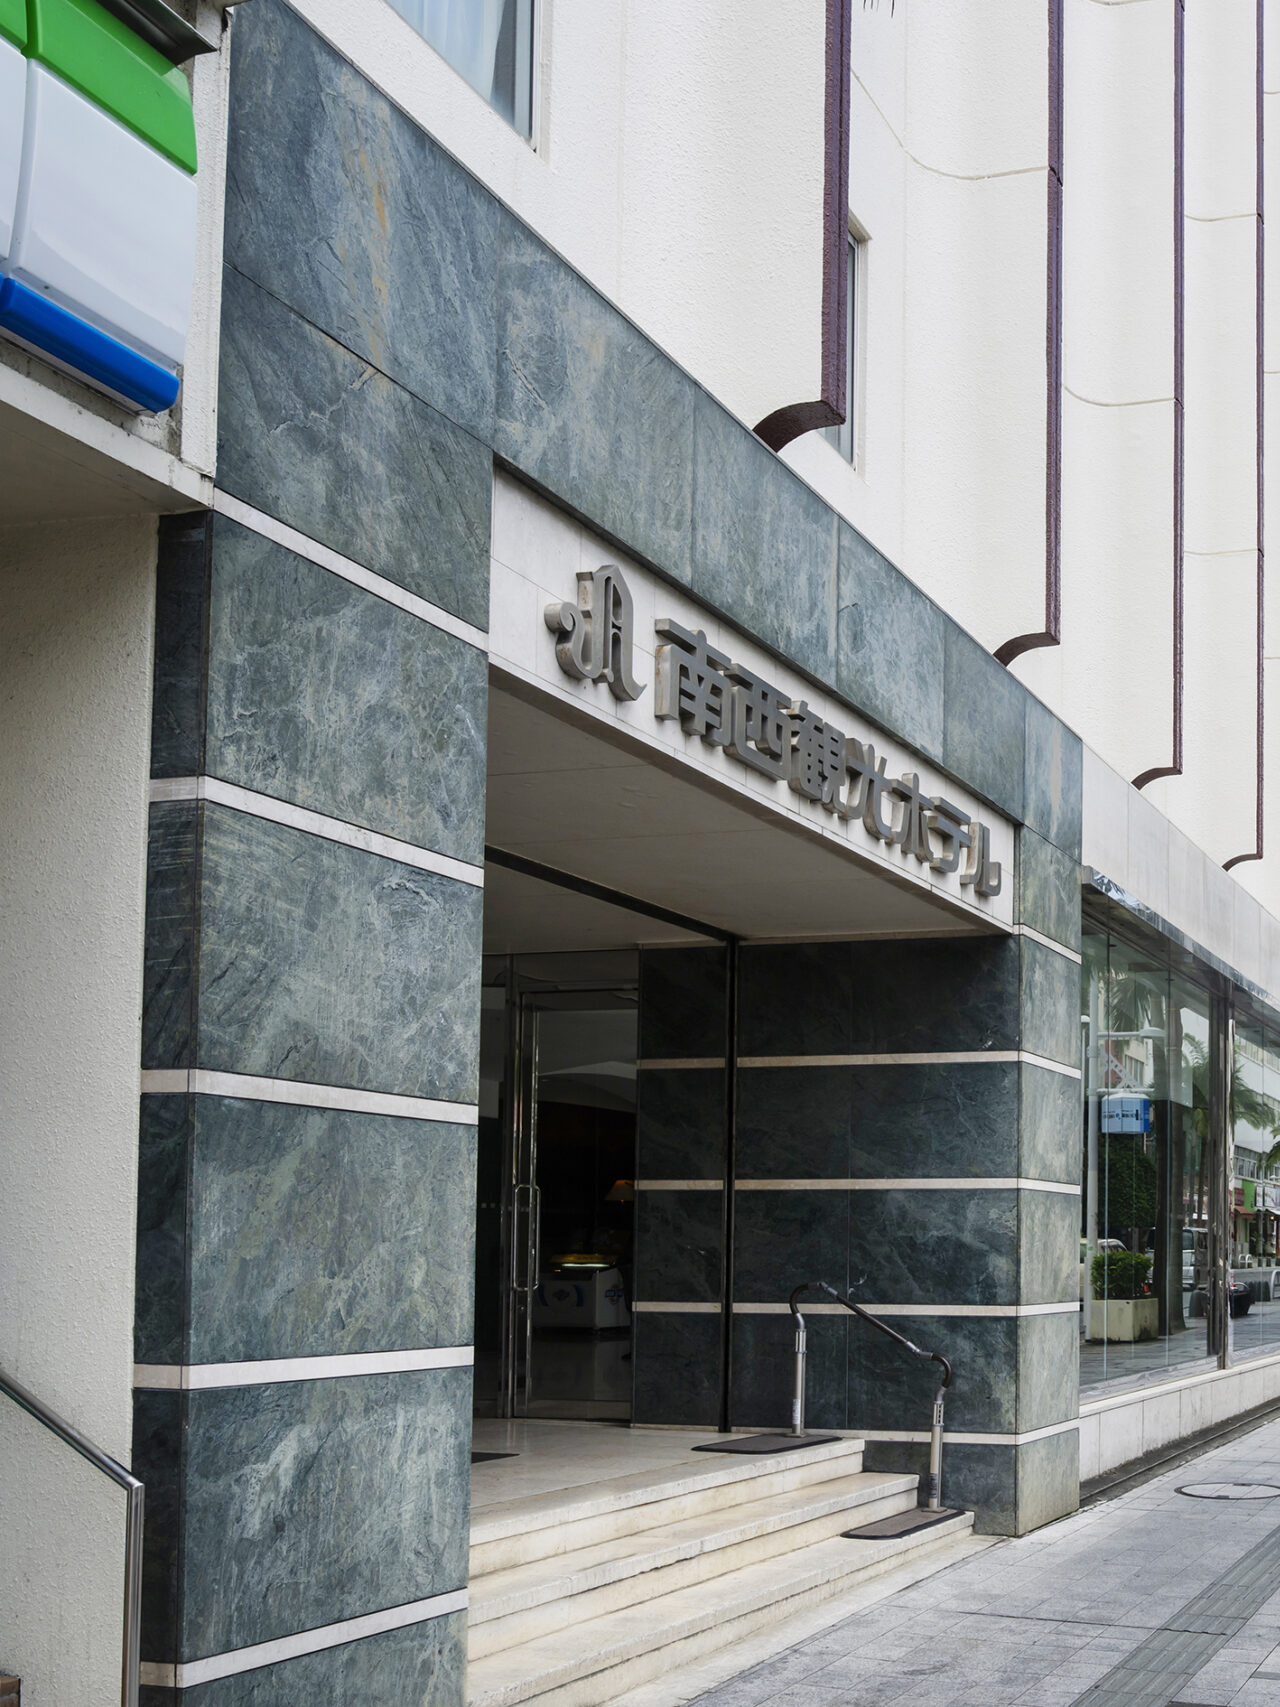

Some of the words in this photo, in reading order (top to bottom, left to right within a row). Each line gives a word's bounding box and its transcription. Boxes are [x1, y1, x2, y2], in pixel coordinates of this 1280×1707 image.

[654, 618, 1001, 897] 南西観光ホテル
